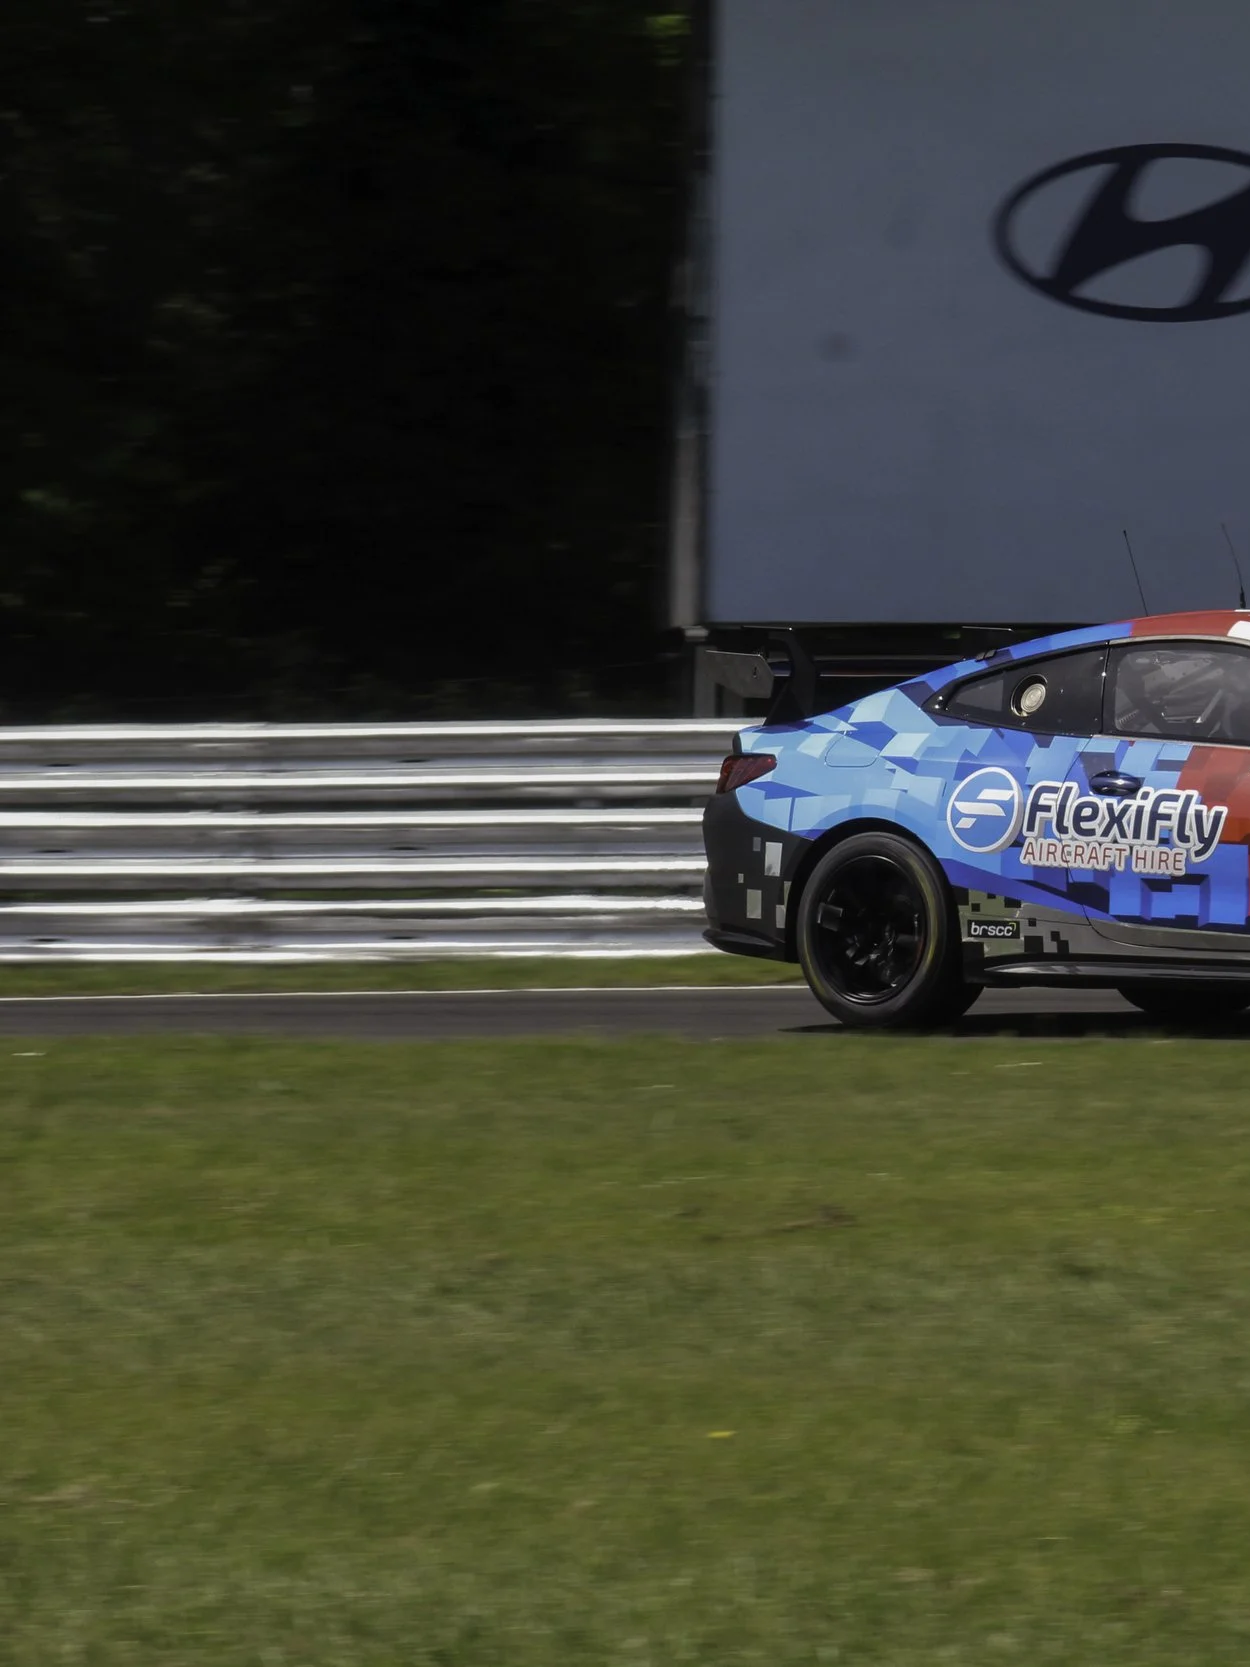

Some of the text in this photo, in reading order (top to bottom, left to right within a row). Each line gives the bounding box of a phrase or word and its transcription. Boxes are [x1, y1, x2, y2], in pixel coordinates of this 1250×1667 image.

[1023, 841, 1185, 872] AIRCRAFT HIRE
[971, 922, 1013, 937] brscc
